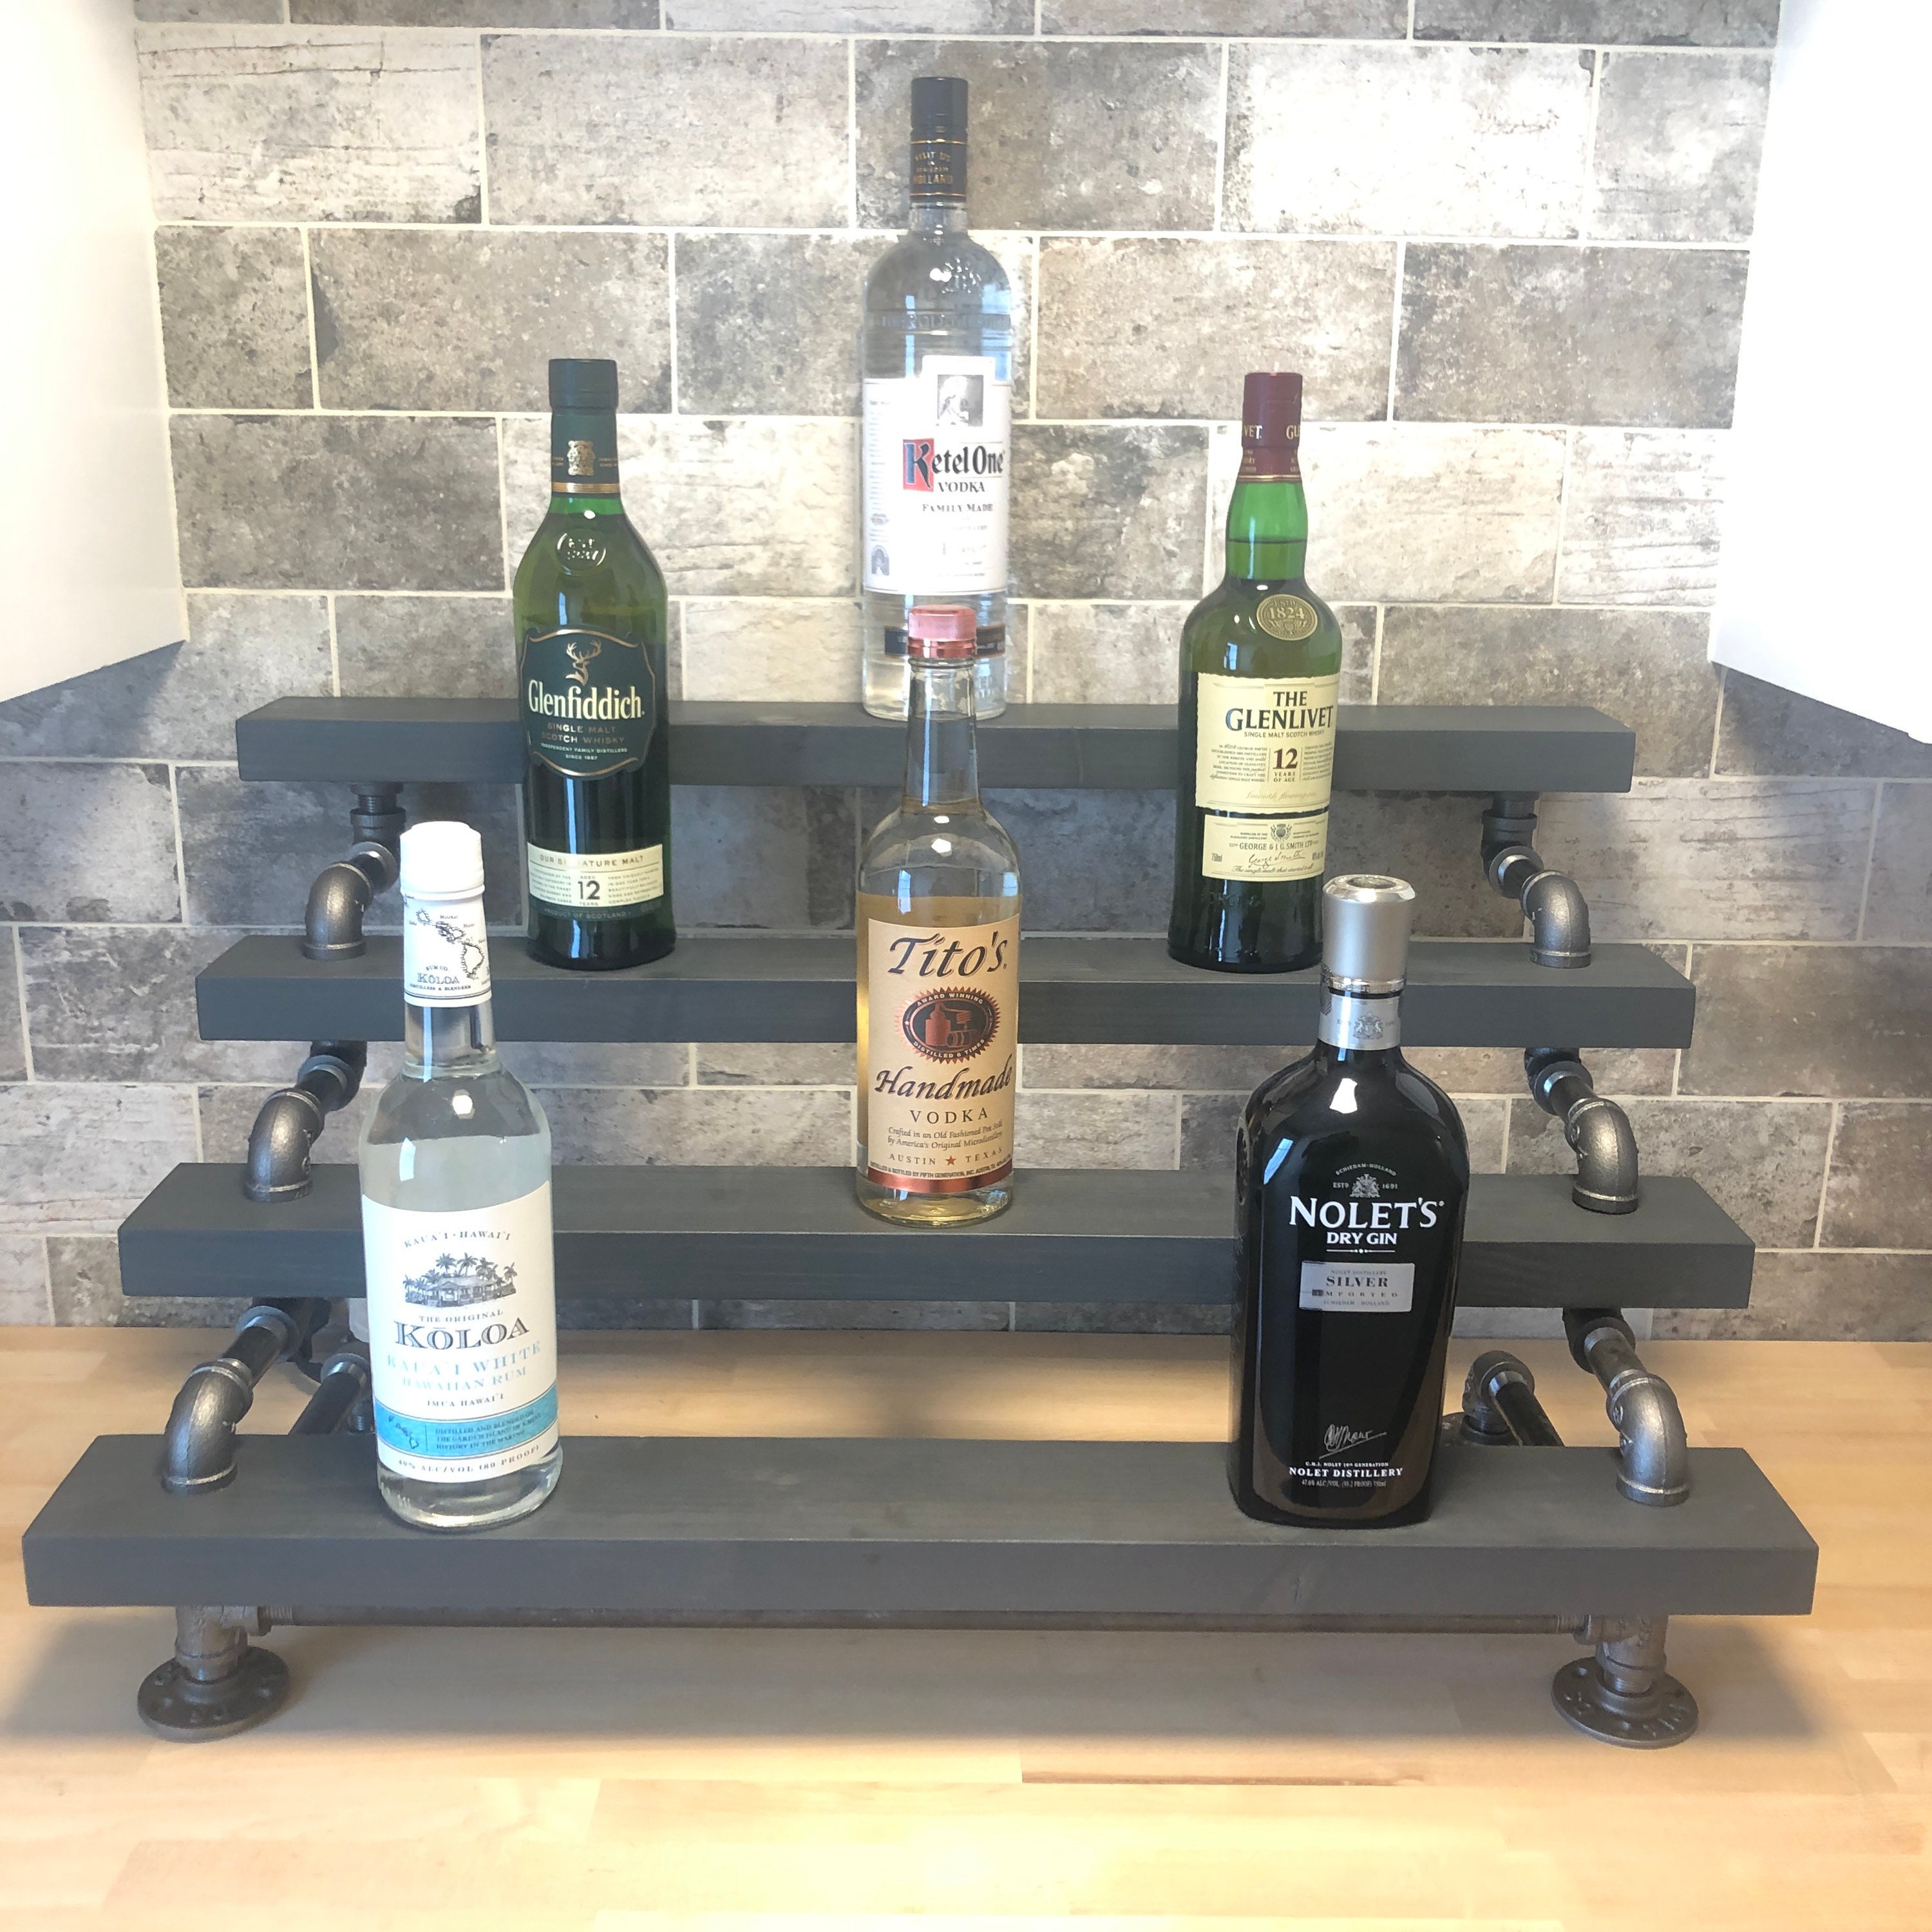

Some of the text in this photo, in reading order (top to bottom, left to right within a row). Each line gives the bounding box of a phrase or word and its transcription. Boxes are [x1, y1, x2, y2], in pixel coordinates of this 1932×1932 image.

[904, 442, 1003, 488] Ketel One
[938, 482, 985, 493] VODKA
[967, 504, 994, 512] MADE
[1269, 607, 1305, 619] 1824
[528, 679, 645, 720] Glenfiddich
[1273, 691, 1307, 706] THE
[1226, 705, 1333, 731] GLENLIVET
[547, 723, 583, 733] SINGLE
[542, 732, 578, 743] SCOTCH
[541, 743, 572, 752] INDEPENDENT
[1273, 748, 1298, 770] 12
[540, 855, 643, 867] OUR SIATURE MALT
[578, 880, 600, 900] 12
[887, 931, 1008, 978] Tito's
[917, 993, 983, 1006] AWARD WINNING
[913, 1041, 953, 1058] DISTILLED
[965, 1039, 985, 1055] TIMES
[874, 1054, 1012, 1100] Handmade
[910, 1108, 989, 1124] VODKA
[888, 1127, 911, 1138] Crafted
[949, 1127, 981, 1138] Fashioned
[887, 1135, 895, 1146] by
[896, 1138, 929, 1149] America's
[931, 1141, 961, 1151] Original
[889, 1153, 936, 1165] AUSTIN
[965, 1147, 1002, 1163] TEXAS
[1289, 1196, 1437, 1229] NOLET'S
[1327, 1232, 1397, 1245] DRY GIN
[1326, 1276, 1388, 1287] SILVER
[446, 1310, 503, 1322] ORIGINAL
[473, 1341, 541, 1372] WHITE
[402, 1367, 526, 1391] HAWAIIAN RUM
[452, 1434, 484, 1443] GARDEN
[486, 1426, 511, 1437] ISLAND
[501, 1445, 539, 1466] PROOF)
[1289, 1467, 1403, 1477] NOLET DISTILLERY
